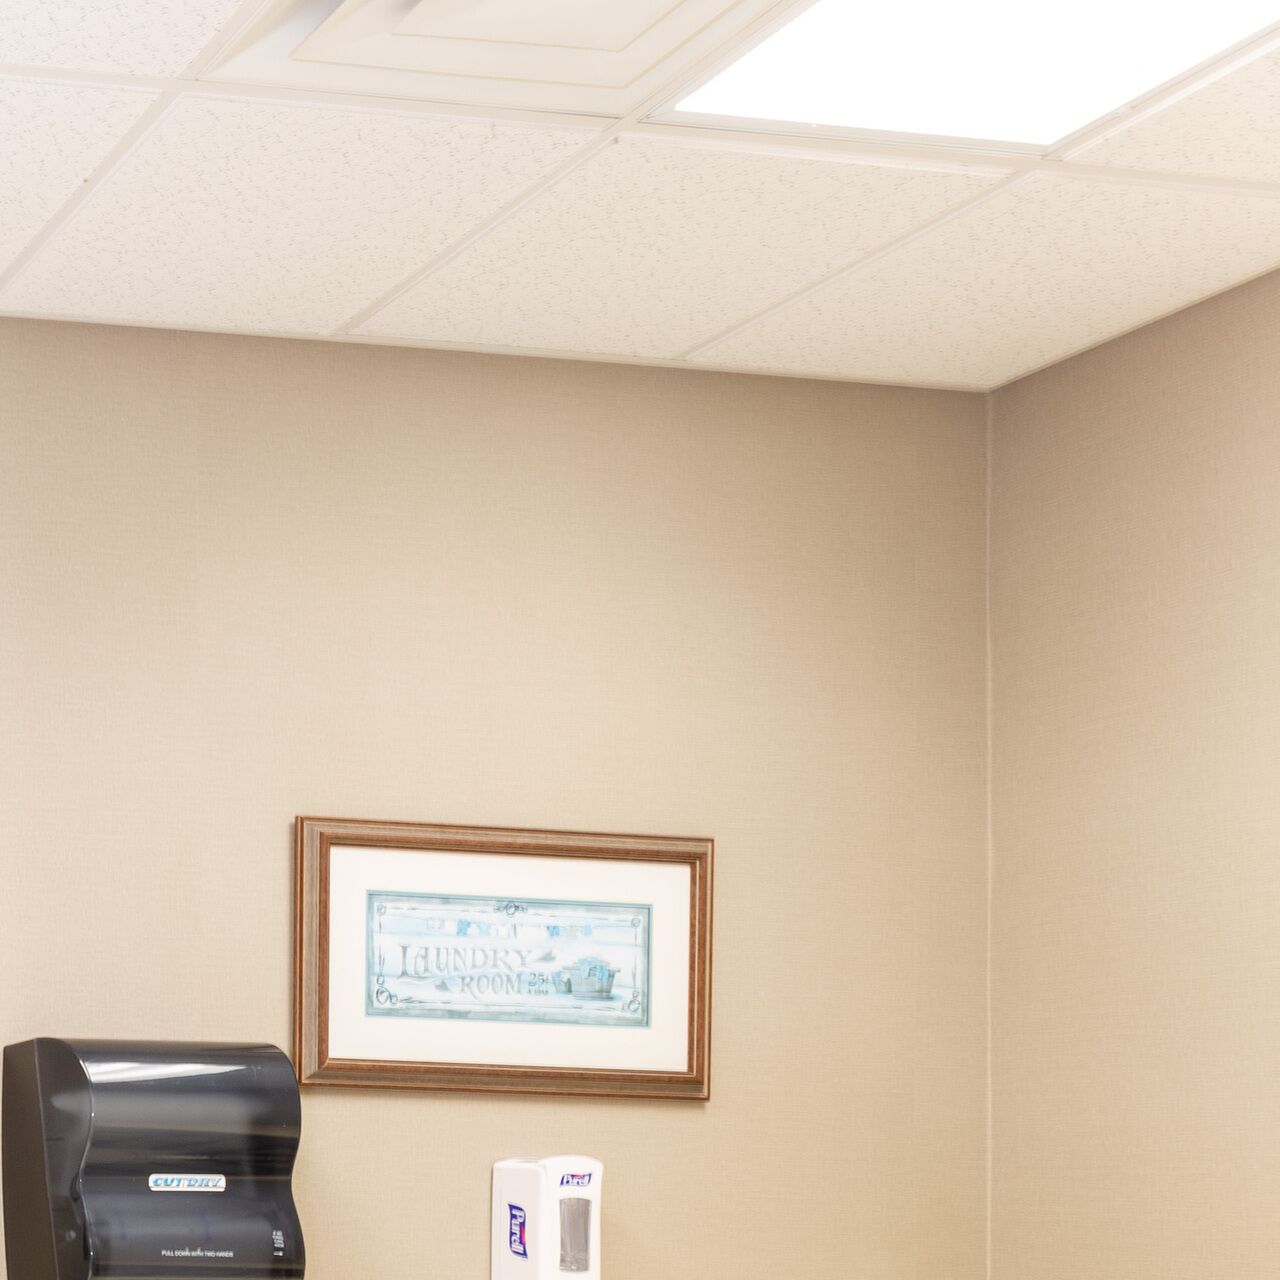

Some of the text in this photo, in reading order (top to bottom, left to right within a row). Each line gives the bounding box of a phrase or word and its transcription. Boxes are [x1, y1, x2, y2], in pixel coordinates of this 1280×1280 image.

[397, 943, 535, 980] LAUNDRY
[459, 974, 523, 1000] ROOM
[161, 1249, 174, 1257] PULL
